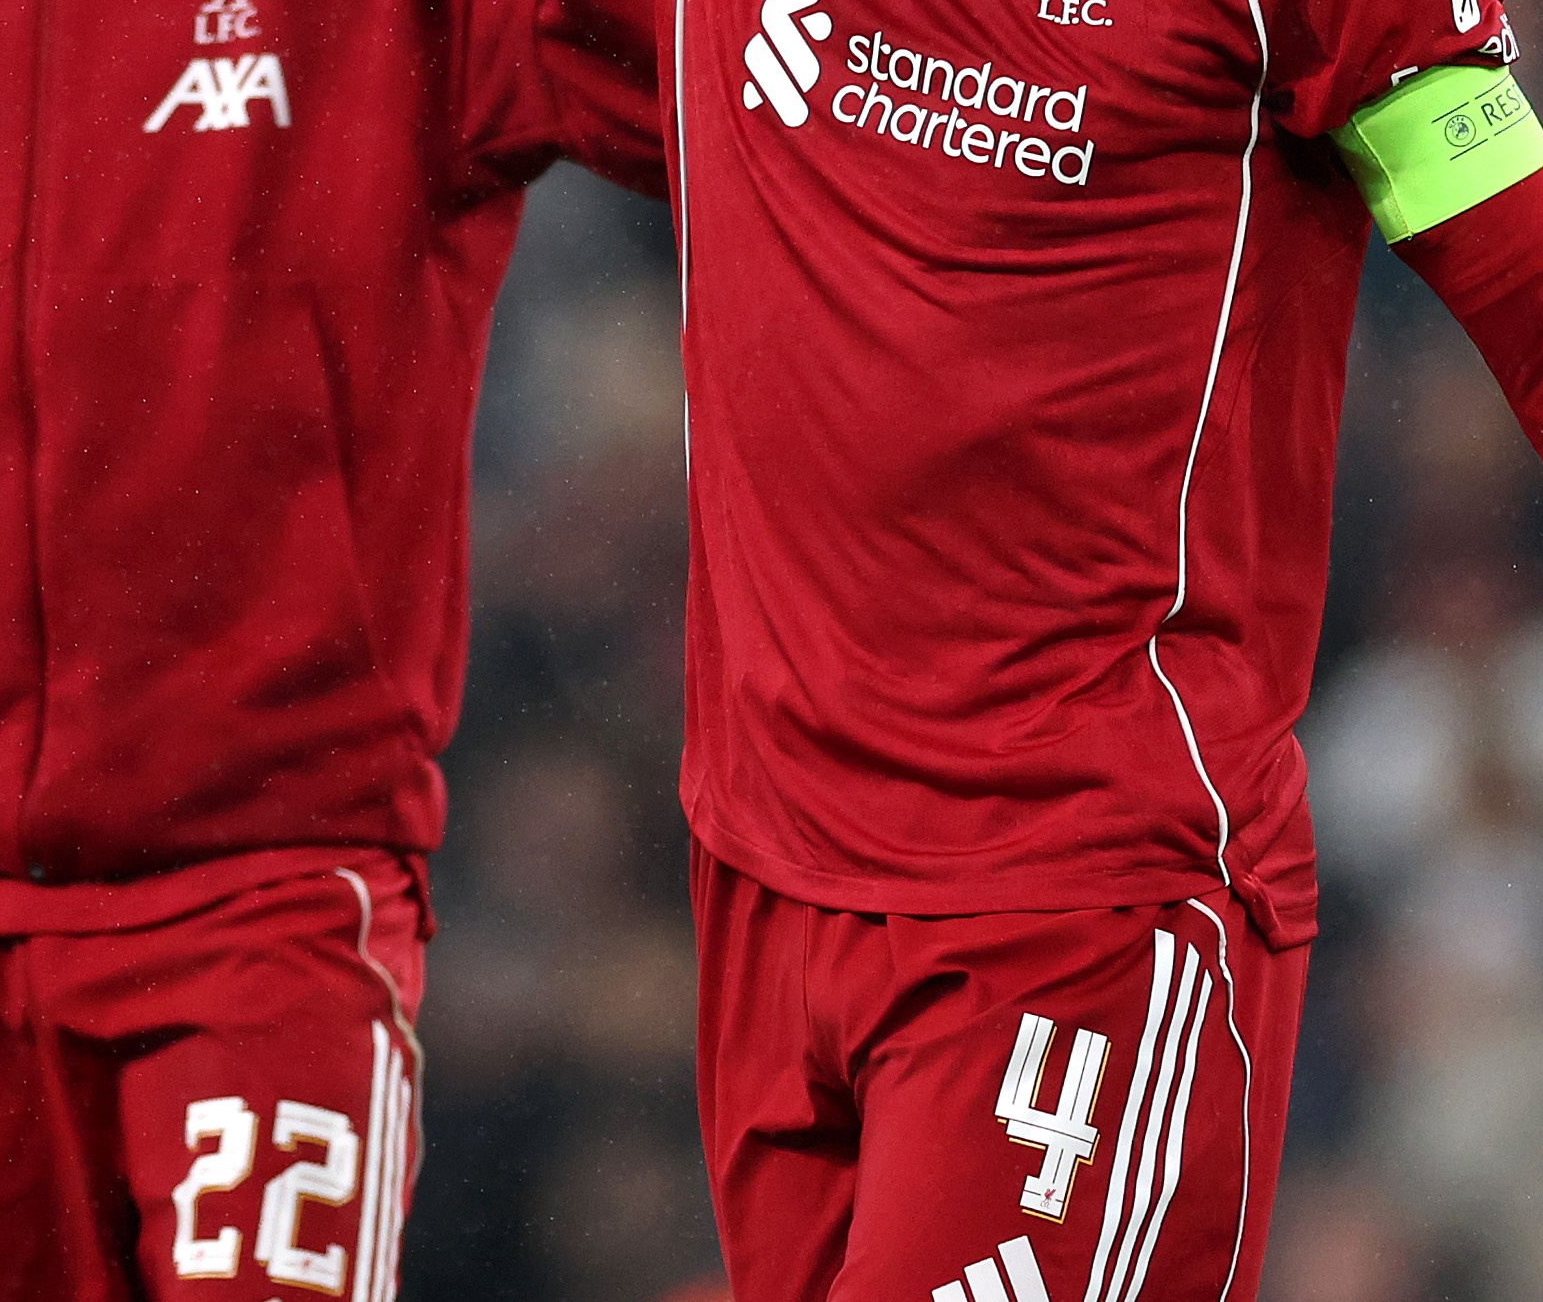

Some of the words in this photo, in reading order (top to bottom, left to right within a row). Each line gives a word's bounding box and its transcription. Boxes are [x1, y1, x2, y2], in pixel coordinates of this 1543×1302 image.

[142, 53, 292, 133] AXA
[846, 30, 1087, 133] standard
[831, 82, 1095, 186] chartered
[994, 1012, 1111, 1224] 4
[171, 1096, 360, 1297] 22
